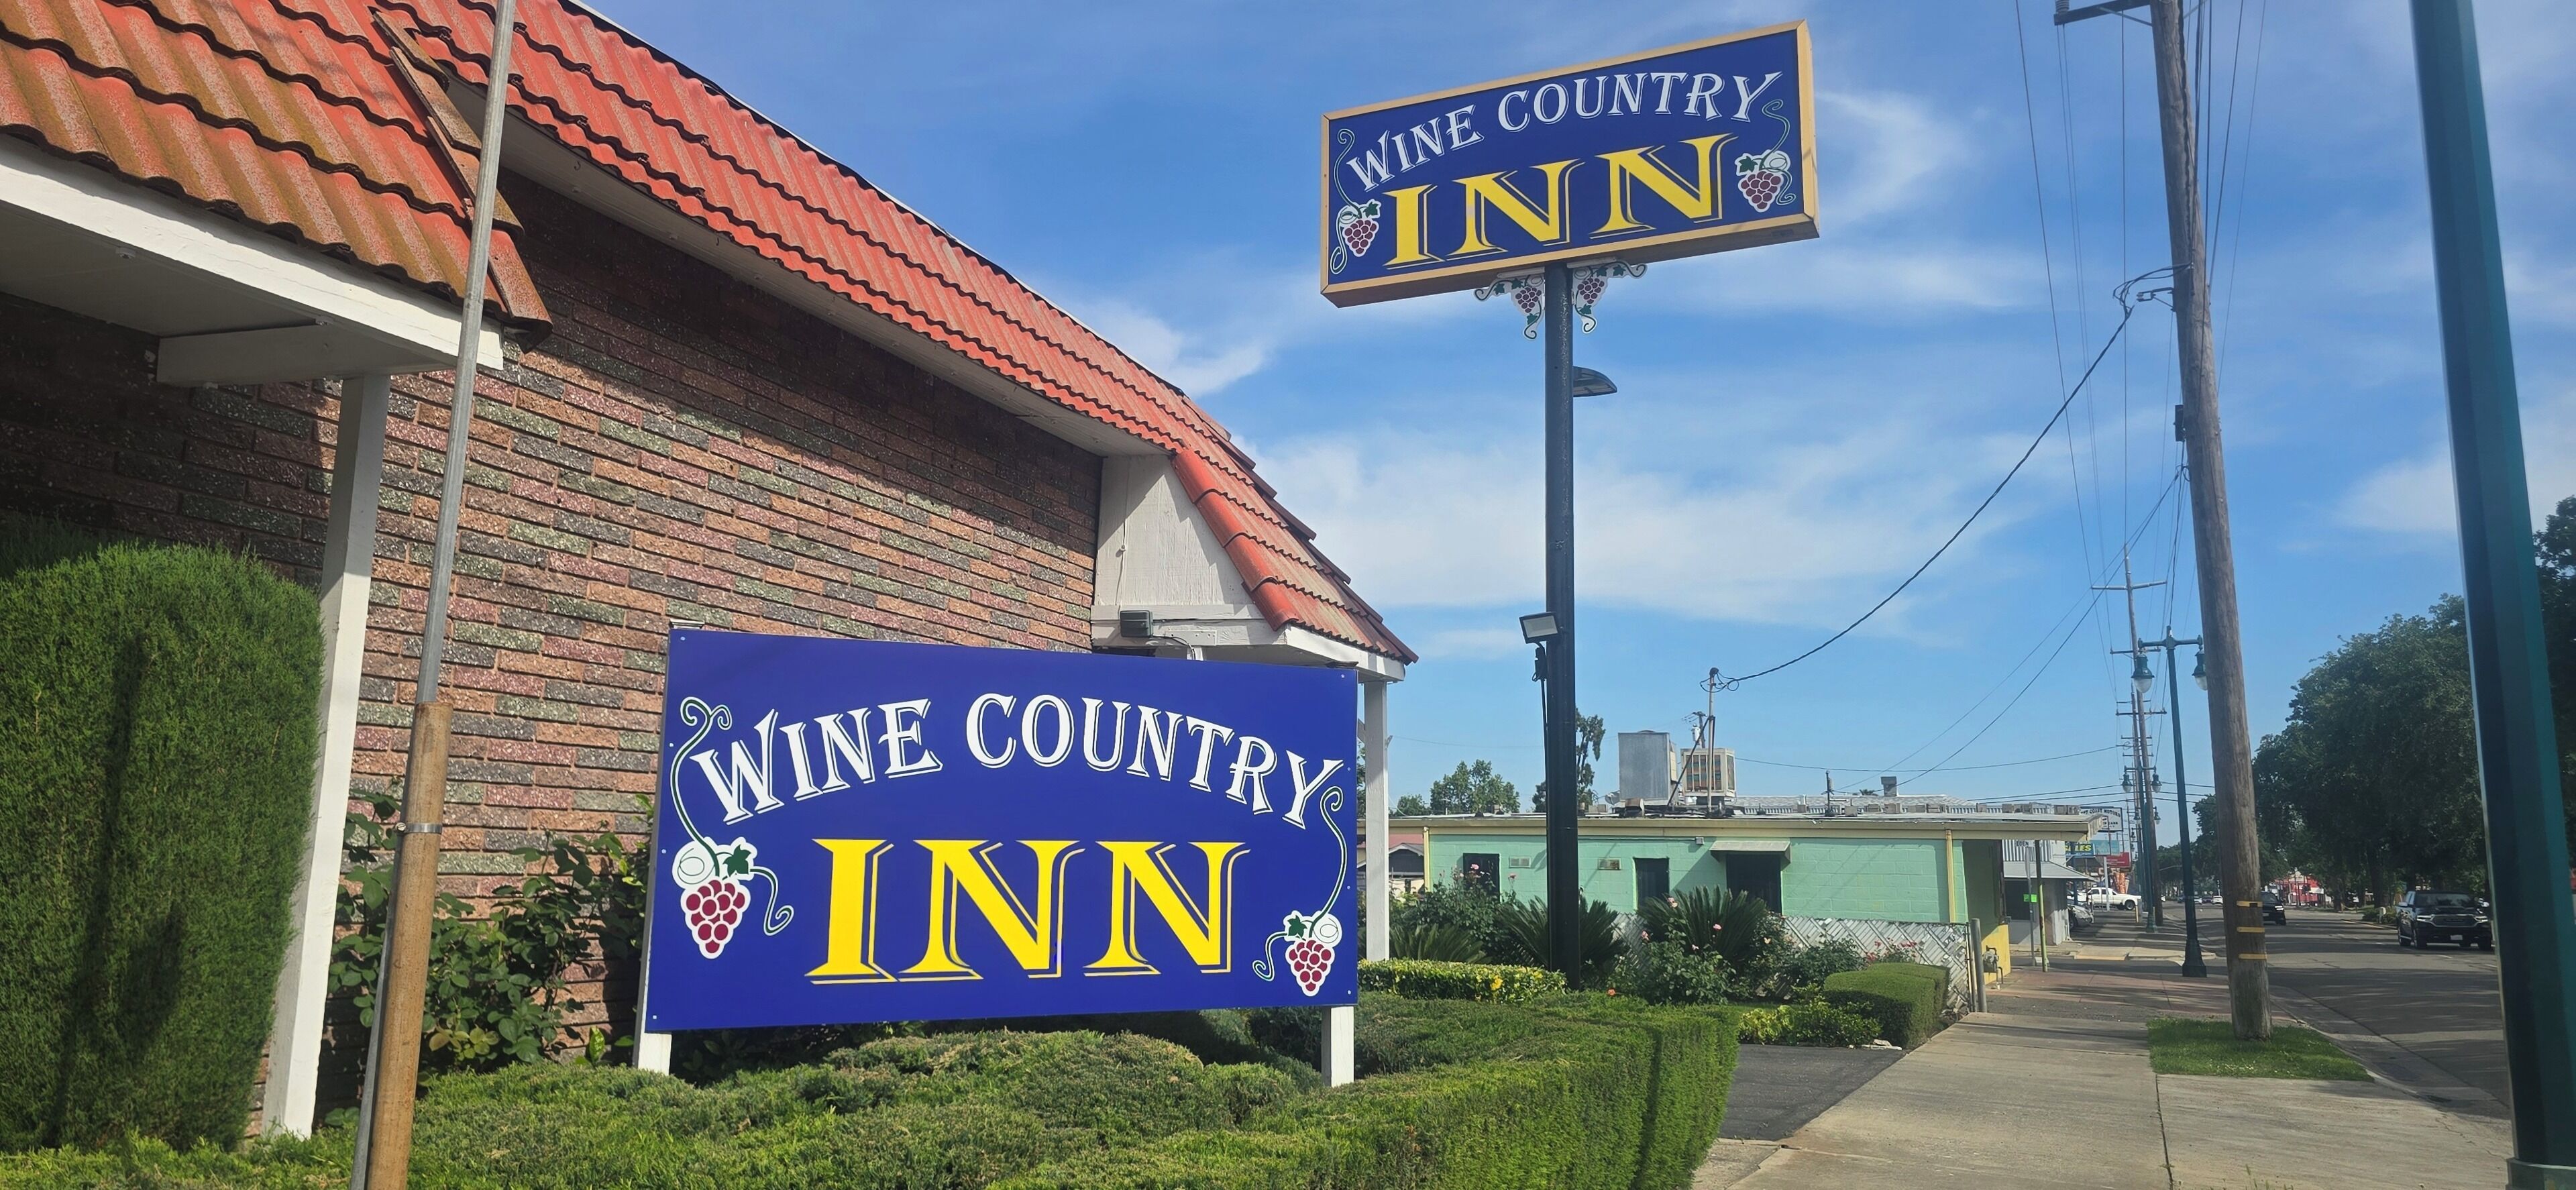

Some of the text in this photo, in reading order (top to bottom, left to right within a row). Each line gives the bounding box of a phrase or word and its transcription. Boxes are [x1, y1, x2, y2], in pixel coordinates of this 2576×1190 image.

[1346, 71, 1782, 193] WINE COUNTRY
[1383, 133, 1739, 270] INN
[690, 693, 1344, 829] WINE COUNTRY
[2104, 809, 2121, 818] MOTORS
[804, 838, 1250, 985] INN
